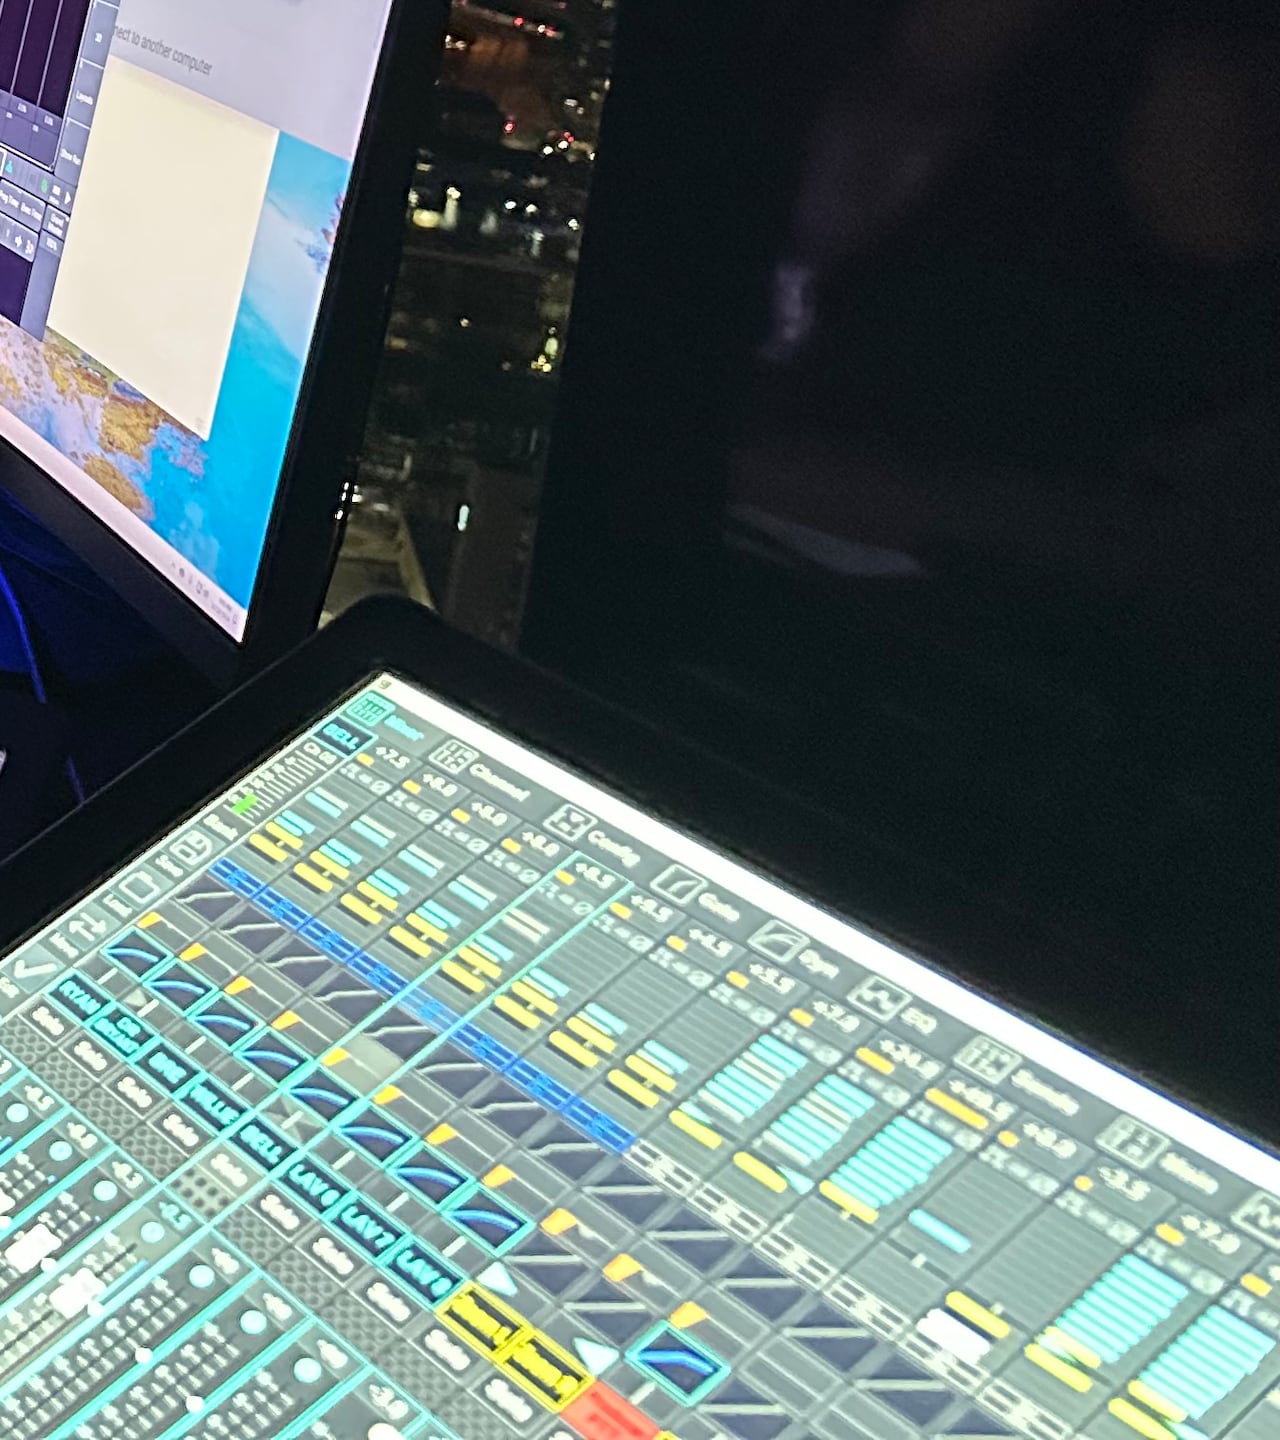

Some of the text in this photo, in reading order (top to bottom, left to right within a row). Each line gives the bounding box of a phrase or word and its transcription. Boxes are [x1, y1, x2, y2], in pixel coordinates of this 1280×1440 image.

[141, 37, 173, 59] another
[172, 49, 213, 76] computer
[469, 763, 531, 802] Channel
[58, 978, 101, 1017] RYAN
[240, 1124, 282, 1164] BELL
[288, 1167, 322, 1200] LAV
[340, 1205, 378, 1240] LAV
[395, 1249, 434, 1284] LAV
